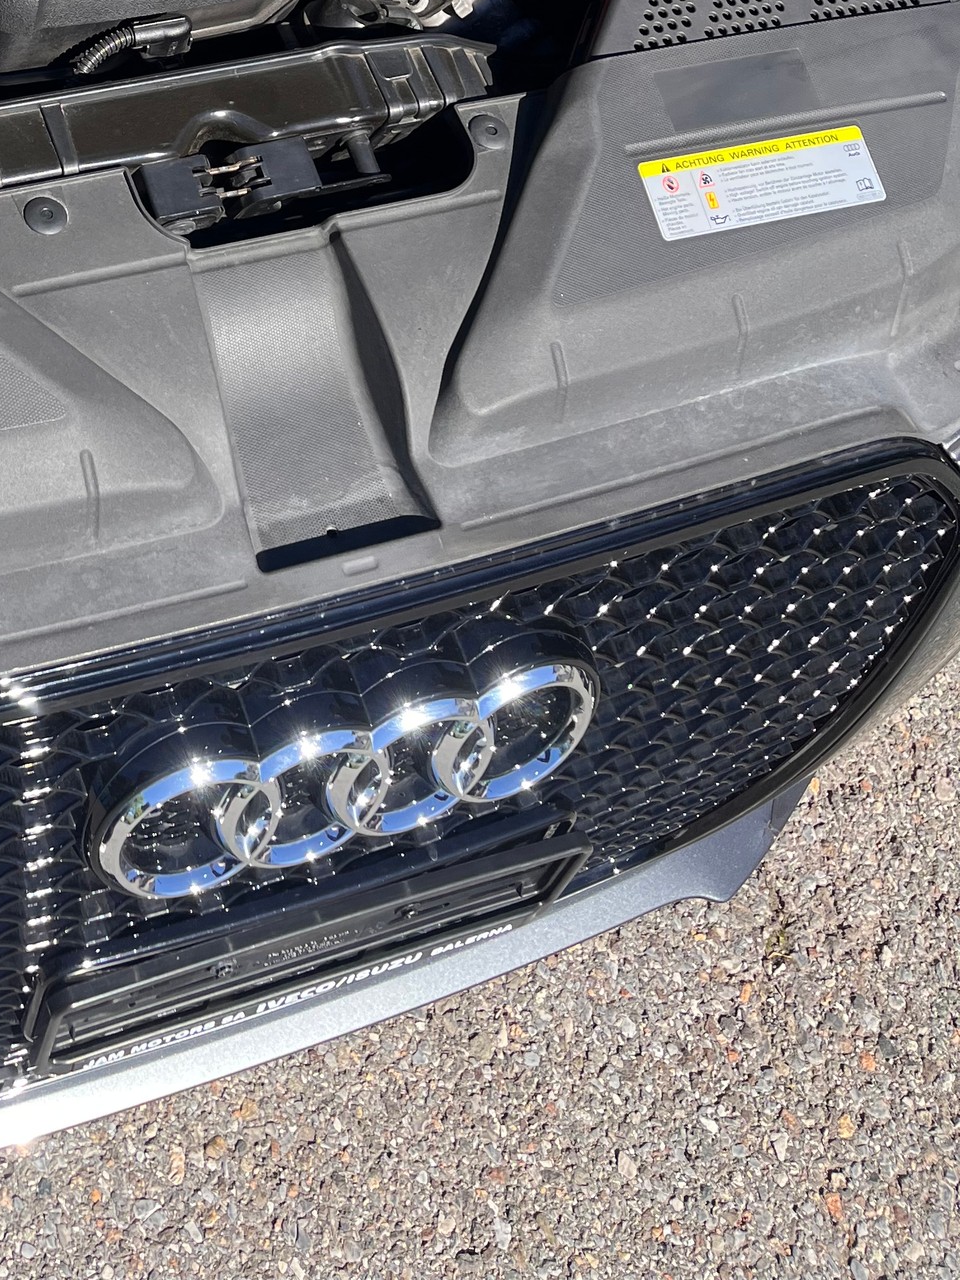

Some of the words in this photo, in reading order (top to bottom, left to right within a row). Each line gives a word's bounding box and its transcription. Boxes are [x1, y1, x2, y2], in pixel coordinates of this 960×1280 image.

[675, 154, 725, 170] ACHTUNG
[729, 144, 780, 160] WARNING
[785, 134, 839, 150] ATTENTION
[131, 1021, 216, 1053] MOTORS
[221, 1011, 245, 1025] SA
[256, 952, 422, 1012] IVECO/ISUZU
[431, 923, 513, 956] BALERNA
